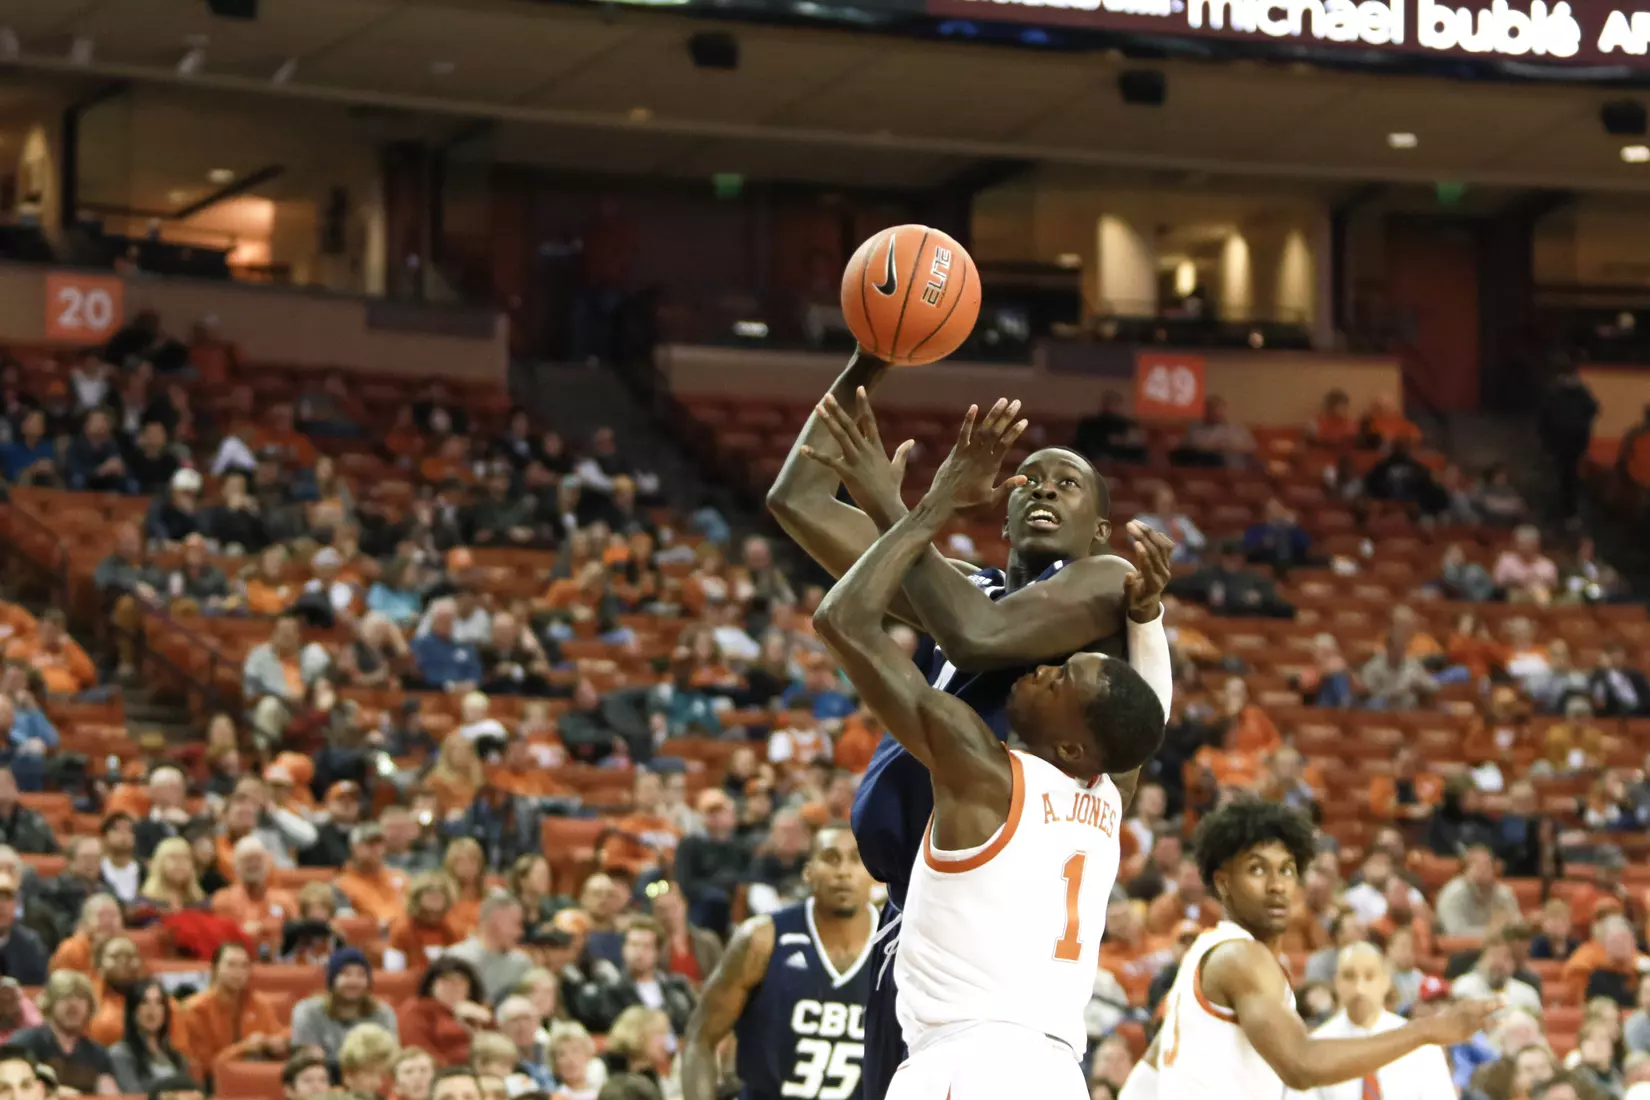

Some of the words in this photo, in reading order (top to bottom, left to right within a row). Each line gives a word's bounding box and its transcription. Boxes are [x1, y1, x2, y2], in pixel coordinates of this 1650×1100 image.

[1187, 0, 1405, 45] michael
[920, 245, 952, 307] ELITE
[57, 287, 113, 330] 20
[1143, 365, 1196, 407] 49
[1065, 792, 1117, 838] JONES
[1052, 850, 1087, 964] 1
[781, 1037, 865, 1100] 35
